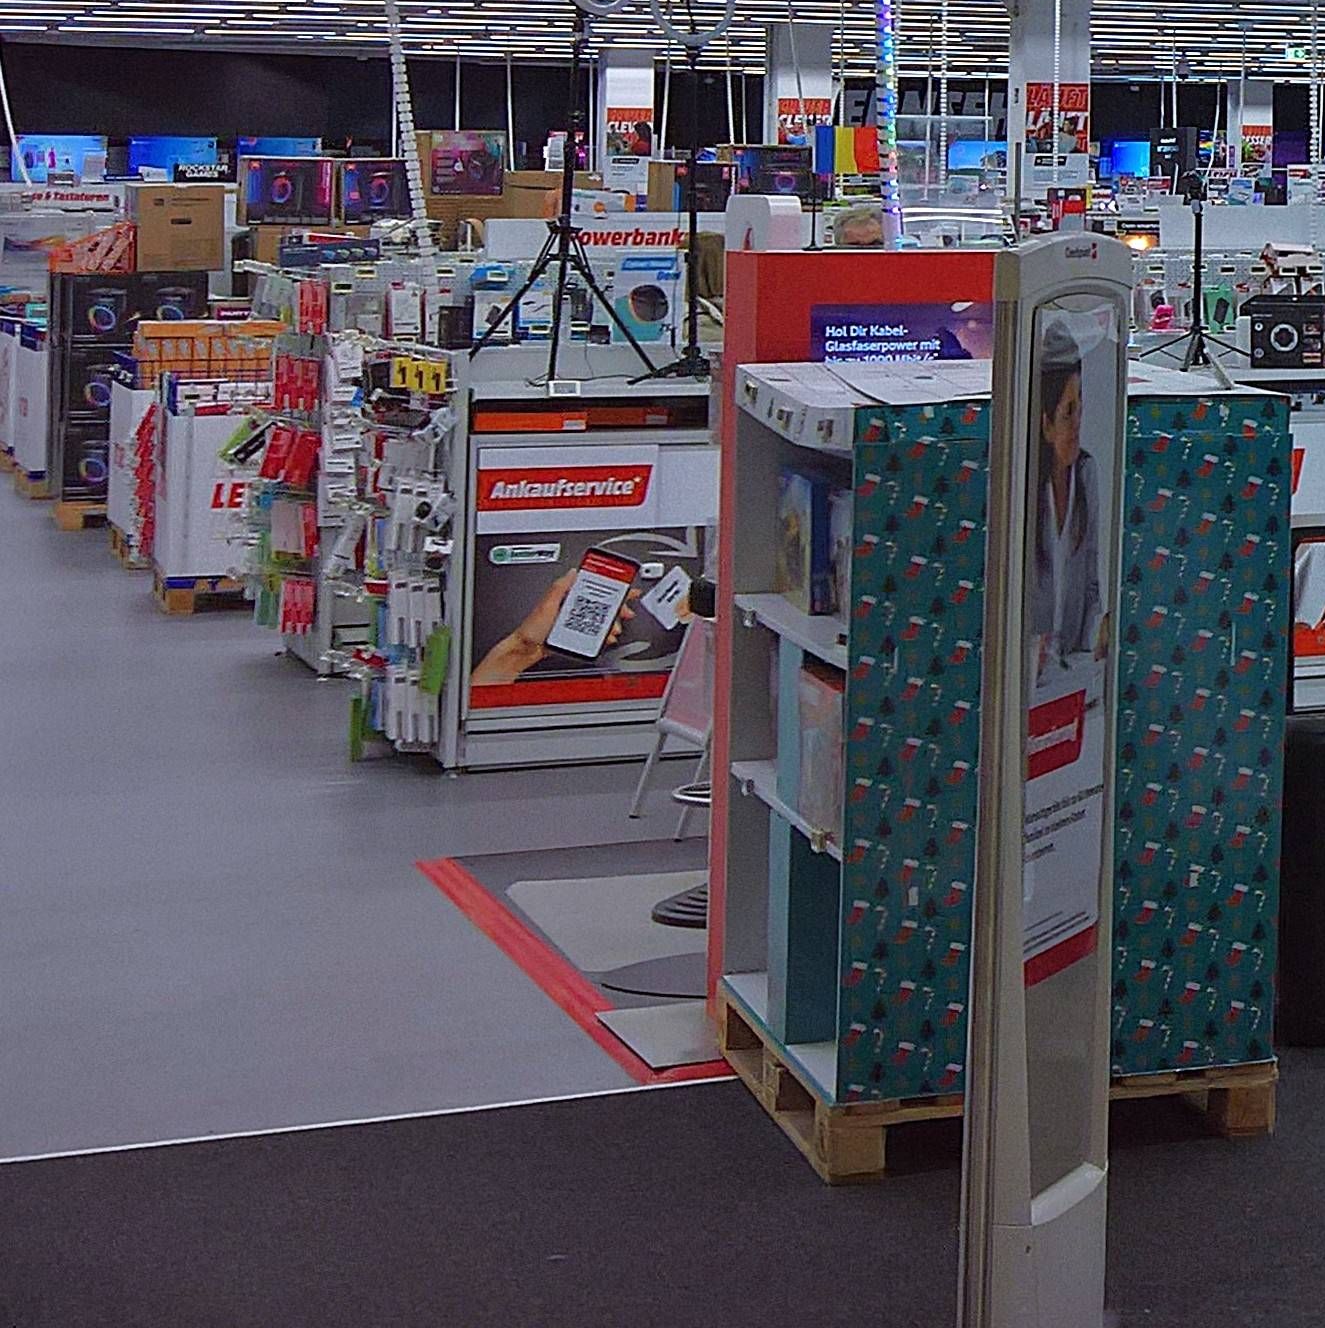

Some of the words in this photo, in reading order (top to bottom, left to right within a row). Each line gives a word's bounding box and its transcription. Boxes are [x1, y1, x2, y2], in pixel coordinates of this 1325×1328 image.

[825, 326, 847, 337] Hol
[850, 325, 868, 336] Dir
[870, 325, 909, 337] Kabel-
[825, 340, 918, 353] Glasfaserpower
[920, 340, 941, 350] mit
